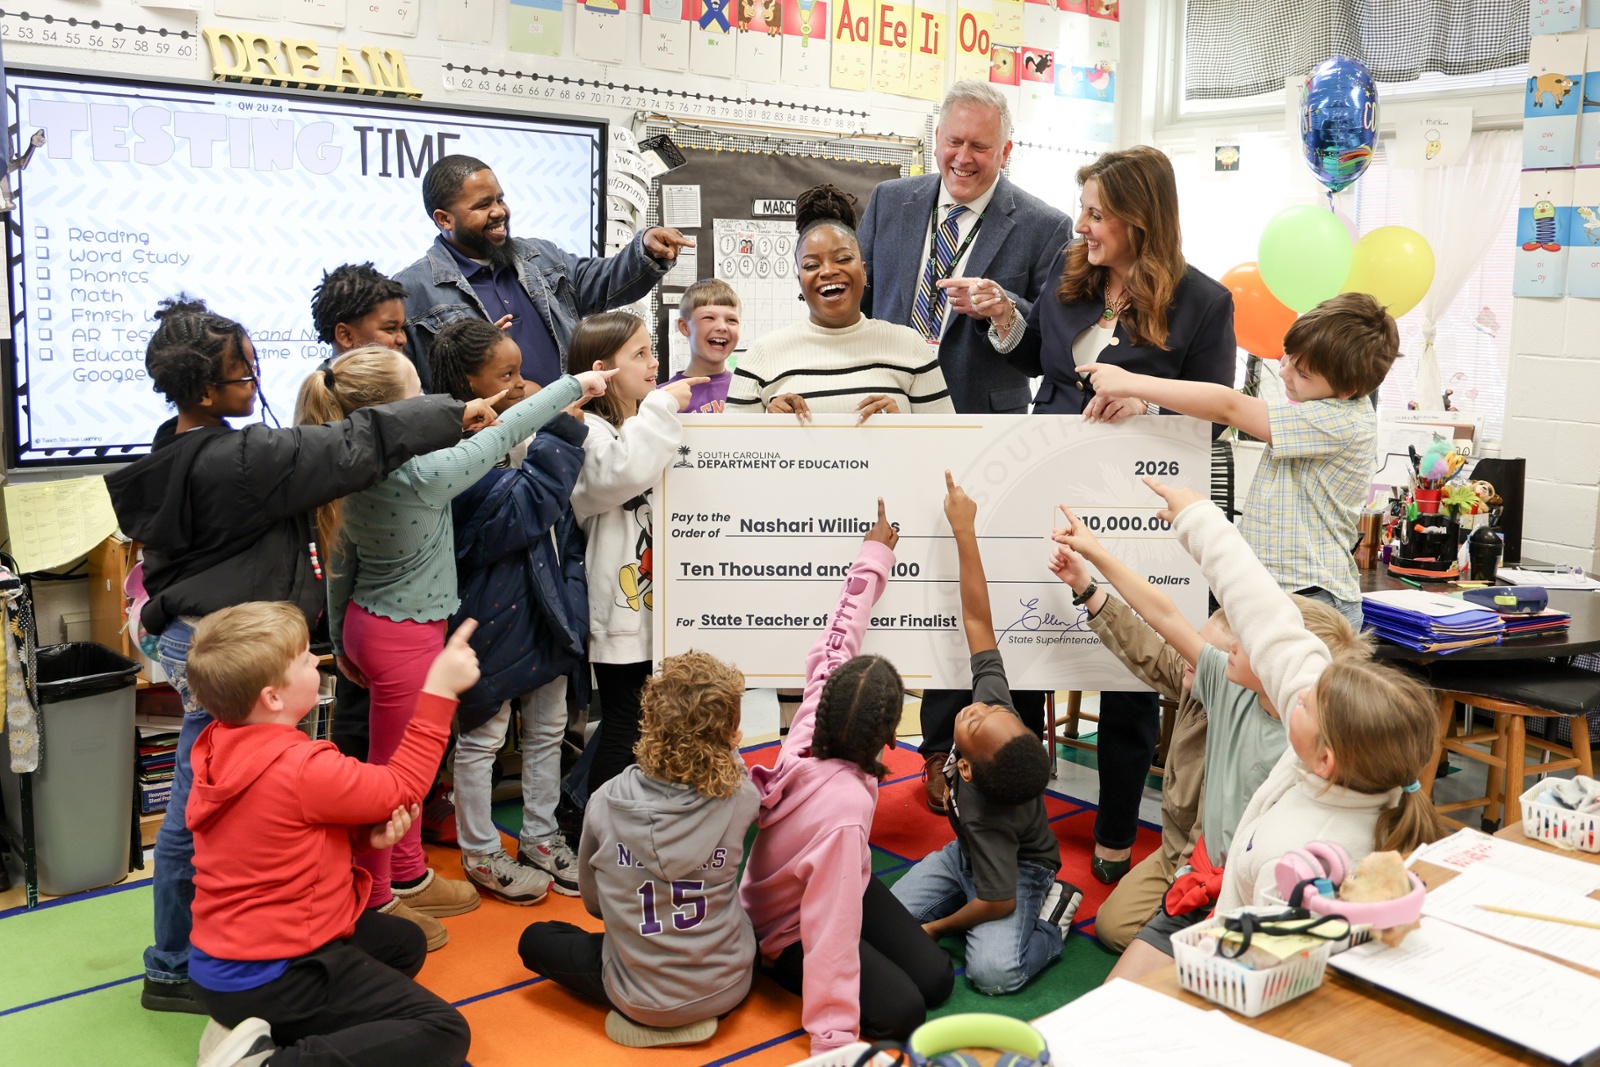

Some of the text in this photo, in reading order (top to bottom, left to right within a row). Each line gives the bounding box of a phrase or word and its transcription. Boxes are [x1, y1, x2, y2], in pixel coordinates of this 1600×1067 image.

[836, 0, 869, 42] Aa
[879, 4, 907, 48] Ee
[920, 12, 939, 55] Ii
[960, 13, 990, 55] Oo
[18, 27, 34, 40] 53
[42, 30, 57, 42] 54
[65, 33, 81, 45] 55
[88, 36, 104, 48] 56
[111, 38, 126, 50] 57
[134, 40, 149, 53] 58
[156, 43, 171, 55] 59
[178, 46, 192, 57] 60
[202, 27, 416, 90] DREAM
[238, 102, 254, 111] QW
[462, 78, 473, 89] 62
[478, 80, 490, 91] 63
[495, 82, 507, 93] 64
[512, 84, 524, 94] 65
[528, 86, 540, 96] 66
[544, 88, 555, 98] 67
[560, 89, 571, 99] 68
[575, 91, 586, 101] 69
[590, 92, 600, 103] 70
[606, 94, 615, 104] 71
[621, 96, 632, 106] 72
[636, 97, 647, 107] 73
[650, 99, 661, 109] 74
[664, 101, 675, 111] 75
[679, 102, 689, 113] 76
[693, 104, 702, 114] 77
[706, 106, 716, 116] 78
[720, 107, 729, 117] 79
[734, 108, 744, 118] 80
[748, 110, 757, 119] 81
[761, 111, 771, 121] 82
[774, 112, 784, 122] 83
[786, 114, 796, 123] 84
[800, 114, 809, 124] 85
[812, 116, 821, 126] 86
[824, 117, 832, 127] 87
[29, 99, 343, 175] TESTING
[69, 228, 150, 246] Reading
[762, 240, 768, 253] 3
[779, 240, 786, 252] 4
[70, 249, 190, 266] Word Study
[726, 261, 733, 273] 8
[70, 268, 149, 283] Phonics
[71, 288, 123, 303] Math
[72, 308, 133, 323] Finish
[72, 329, 101, 342] AR
[248, 329, 293, 341] rand
[73, 368, 147, 383] Google
[697, 451, 781, 460] SOUTH CAROLINA
[697, 460, 869, 470] DEPARTMENT OF EDUCATION
[1134, 461, 1180, 476] 2026
[671, 512, 731, 524] Pay to the
[1076, 516, 1172, 533] 10,000.00
[671, 528, 721, 538] Order of
[740, 518, 901, 534] Nashari Willias
[680, 562, 715, 577] Ten
[718, 562, 813, 577] Thousand
[1148, 575, 1191, 586] Dollars
[676, 614, 957, 628] For State Teacher of ear Finalist
[1008, 636, 1033, 644] State
[637, 880, 708, 937] 15
